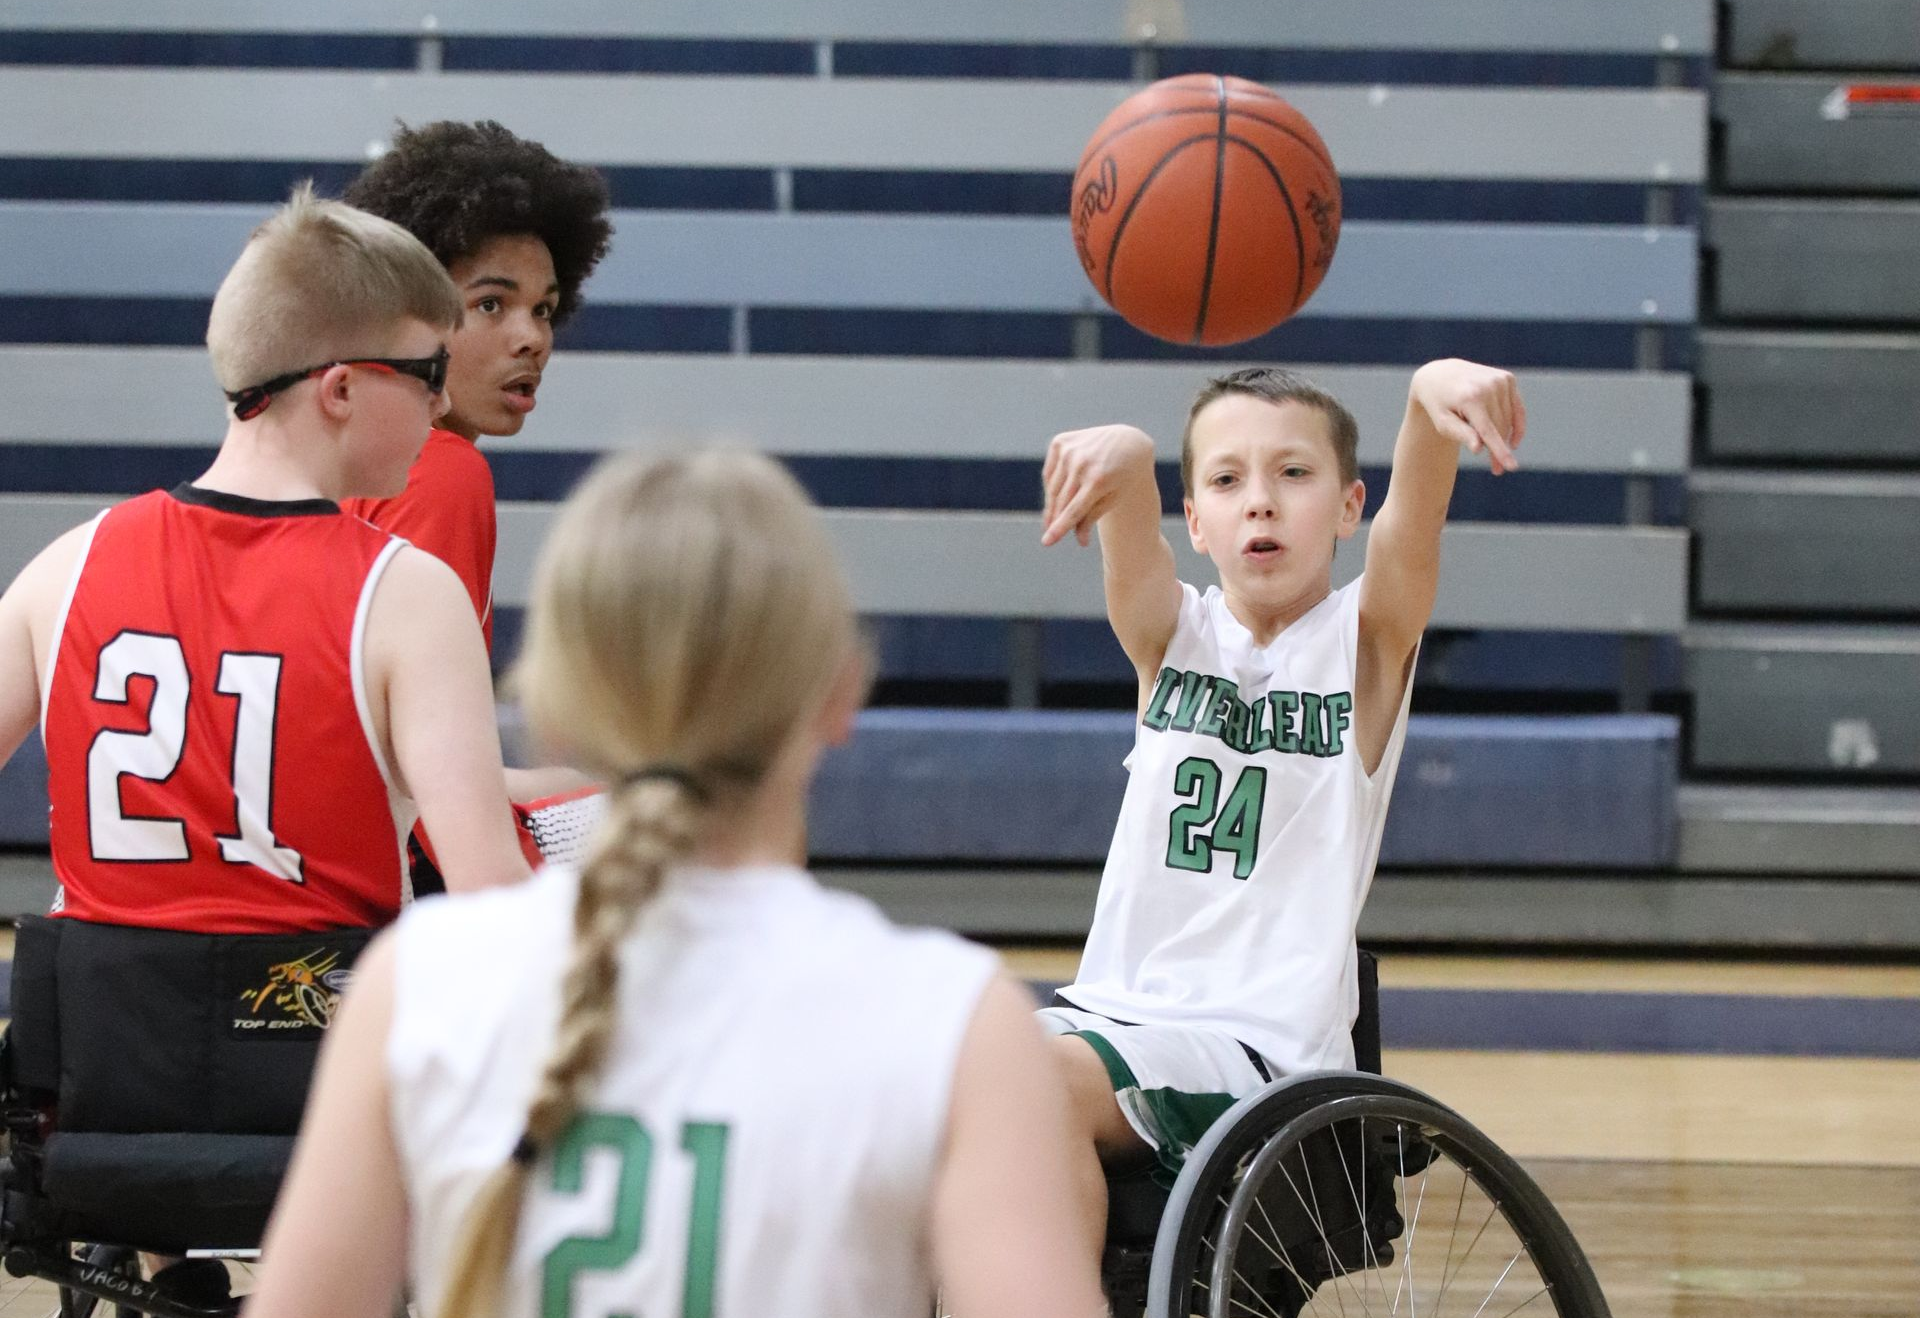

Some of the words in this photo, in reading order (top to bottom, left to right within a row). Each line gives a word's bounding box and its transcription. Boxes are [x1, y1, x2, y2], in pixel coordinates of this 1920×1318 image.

[87, 628, 305, 885] 21
[1165, 756, 1268, 881] 24
[233, 1019, 265, 1029] TOP
[268, 1019, 304, 1029] END
[540, 1111, 730, 1318] 21
